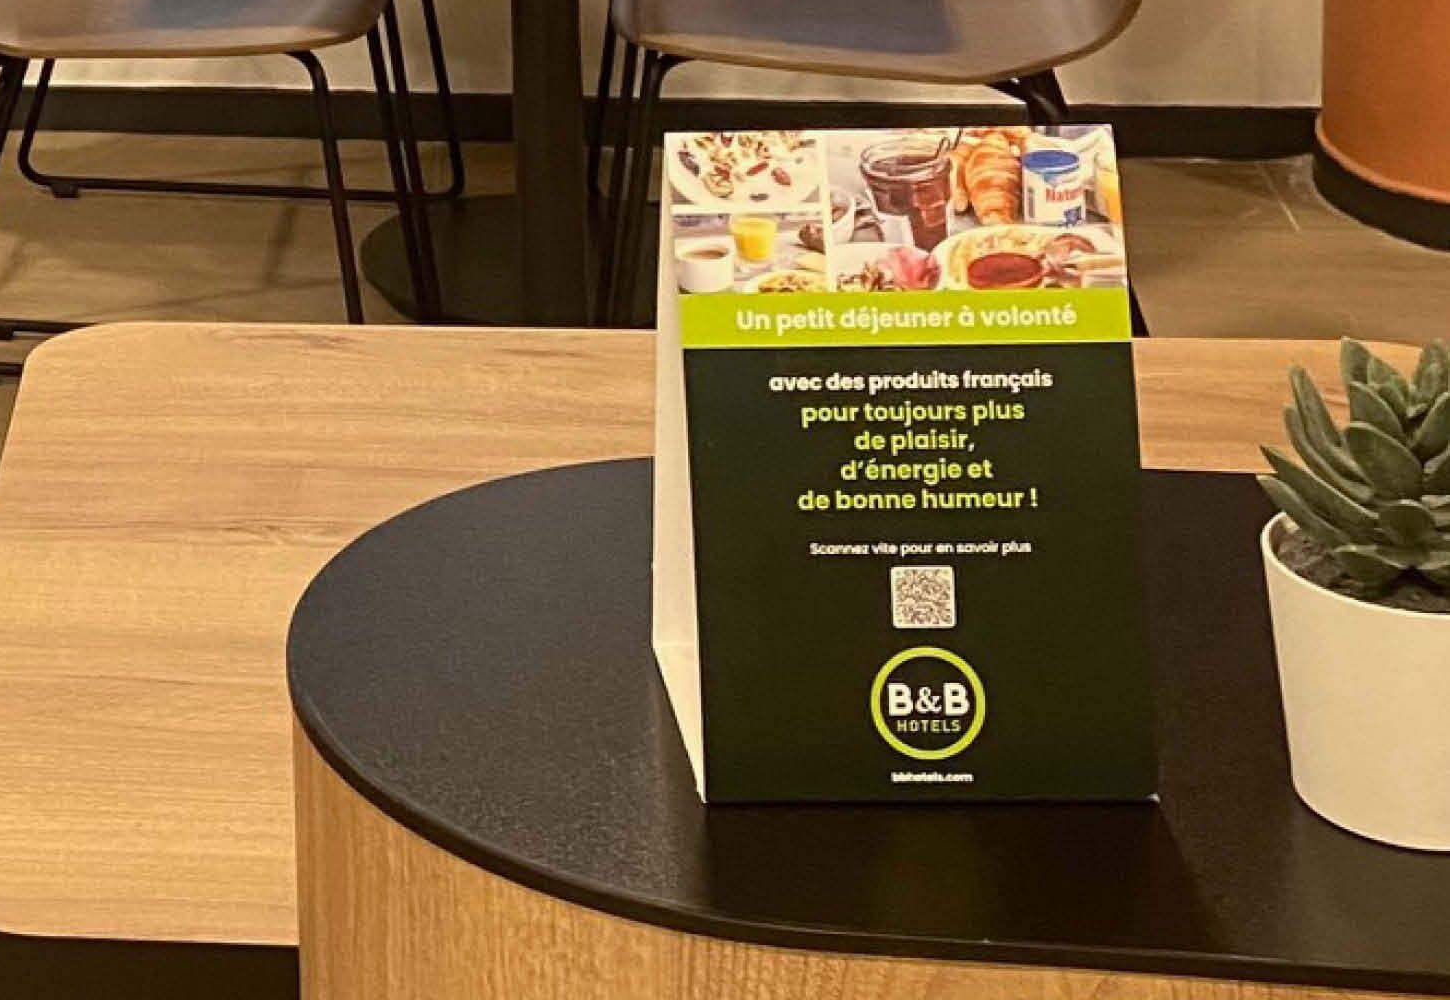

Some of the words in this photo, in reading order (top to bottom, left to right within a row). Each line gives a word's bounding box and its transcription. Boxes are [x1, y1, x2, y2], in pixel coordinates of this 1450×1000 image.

[736, 310, 771, 330] Un
[776, 308, 835, 336] petit
[840, 306, 952, 334] déjeuner
[958, 305, 975, 327] à
[980, 305, 1077, 327] volonté
[769, 374, 822, 391] avec
[825, 372, 865, 390] des
[869, 370, 959, 395] produits
[963, 368, 1053, 393] français
[801, 406, 859, 428] pour
[863, 401, 966, 427] toujours
[972, 400, 1025, 426] plus
[854, 430, 885, 450] de
[891, 428, 975, 456] plaisir,
[841, 457, 962, 485] d'énergie
[967, 459, 994, 479] et
[798, 490, 830, 510] de
[836, 489, 916, 509] bonne
[921, 488, 1025, 509] humeur
[809, 542, 870, 555] Scannez
[871, 541, 898, 555] vite
[900, 543, 934, 557] pour
[936, 543, 954, 554] en
[956, 541, 999, 553] savoir
[1002, 540, 1032, 556] plus
[888, 682, 970, 717] B&B
[897, 719, 962, 733] HOTELS
[891, 771, 974, 782] bbhotels.com
